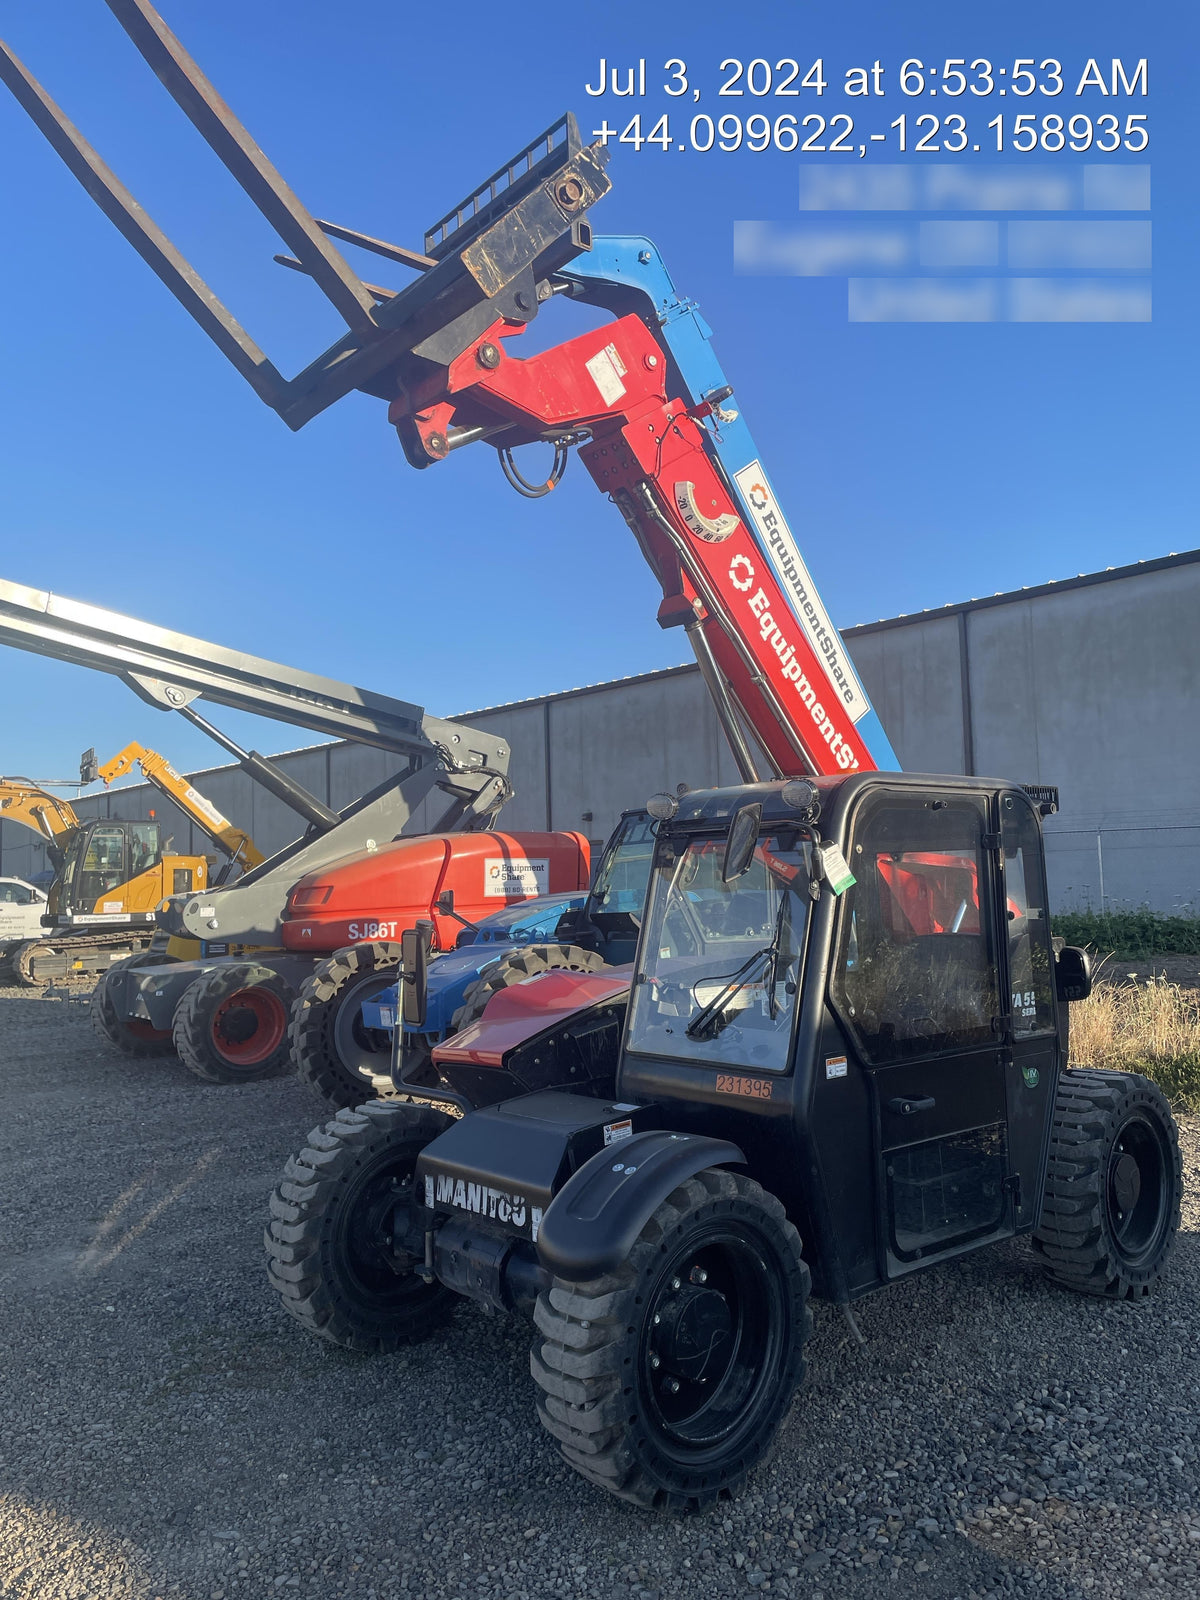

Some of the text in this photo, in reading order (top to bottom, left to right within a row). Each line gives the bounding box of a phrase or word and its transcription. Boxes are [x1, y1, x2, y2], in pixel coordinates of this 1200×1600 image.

[692, 524, 703, 534] 20
[703, 533, 713, 541] 40
[762, 510, 854, 704] EquipmentShare
[748, 588, 859, 769] EquipmentS
[502, 864, 545, 873] Equipment
[348, 922, 397, 939] SJ86T
[717, 1075, 771, 1098] 231395
